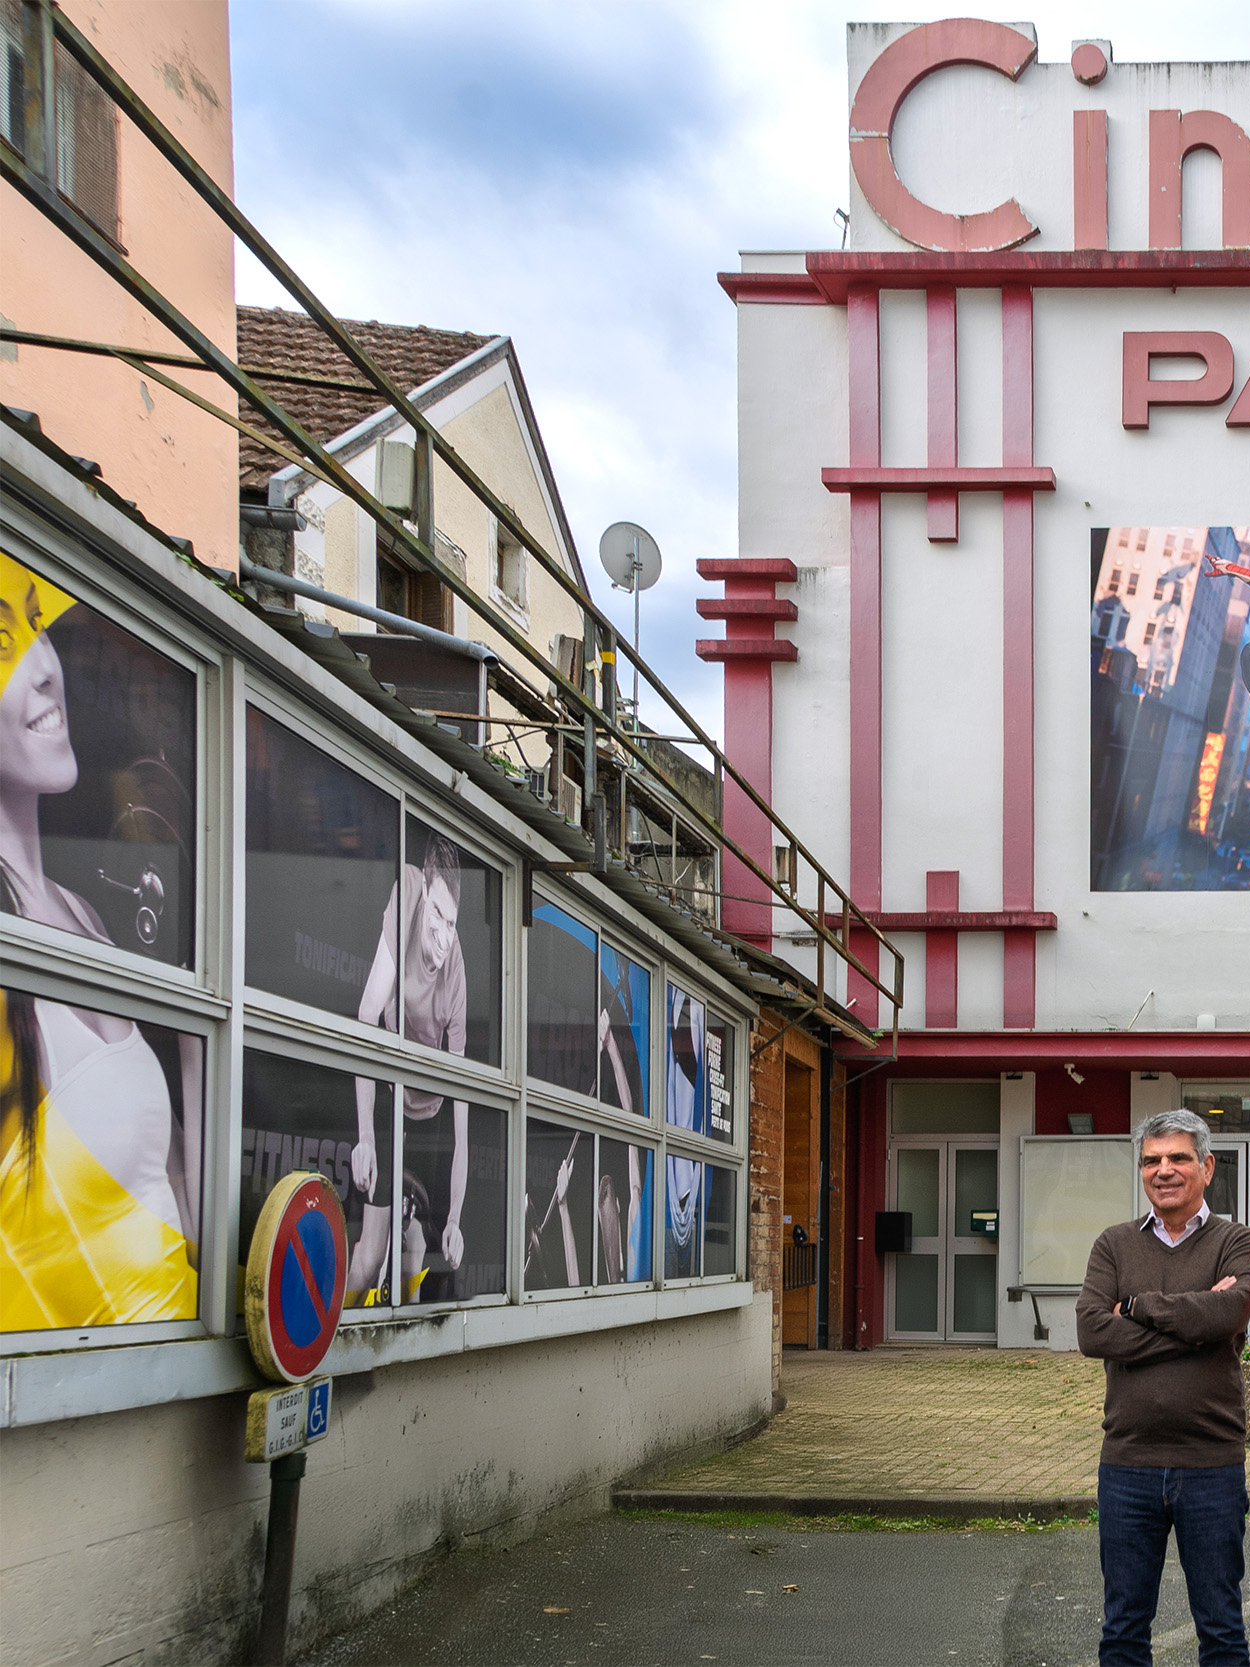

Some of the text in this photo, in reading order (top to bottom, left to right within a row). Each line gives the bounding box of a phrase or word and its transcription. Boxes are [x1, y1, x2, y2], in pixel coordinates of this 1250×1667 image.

[242, 1126, 352, 1203] FITNESS
[276, 1391, 304, 1412] INTERDIT
[280, 1413, 297, 1430] SAUF
